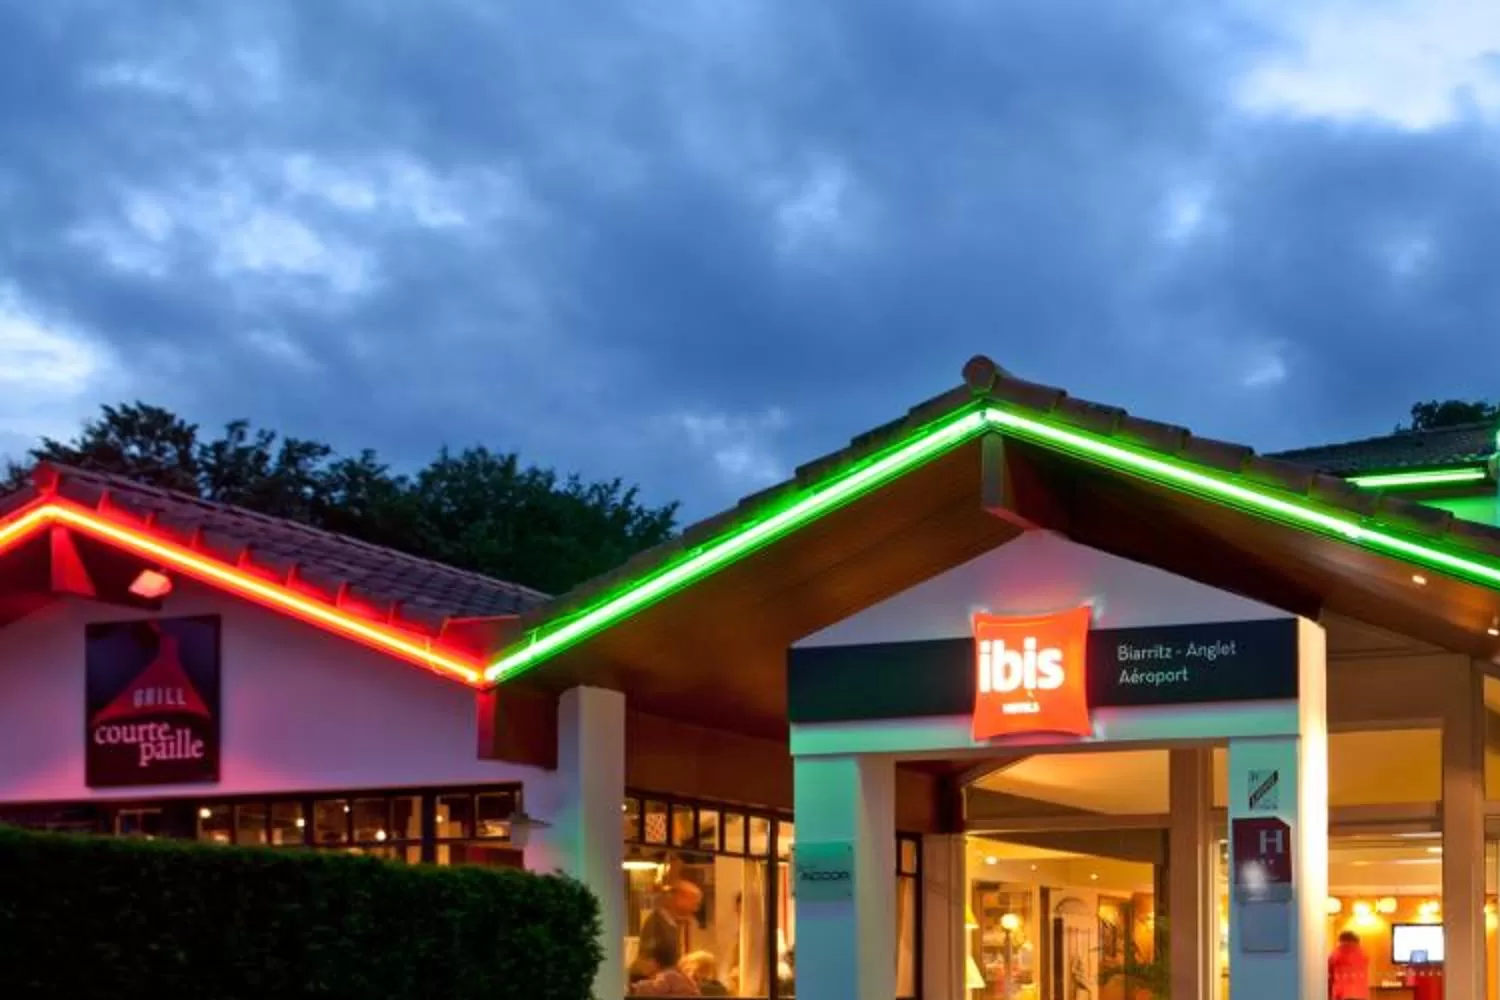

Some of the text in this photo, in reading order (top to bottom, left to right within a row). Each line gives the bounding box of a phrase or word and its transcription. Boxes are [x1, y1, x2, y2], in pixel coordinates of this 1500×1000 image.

[1118, 643, 1172, 661] Biarritz
[1186, 640, 1236, 661] Anglet
[979, 636, 1065, 693] ibis
[1119, 666, 1189, 686] Aéroport
[94, 721, 176, 744] courte
[138, 728, 204, 767] paille
[1259, 829, 1283, 853] H
